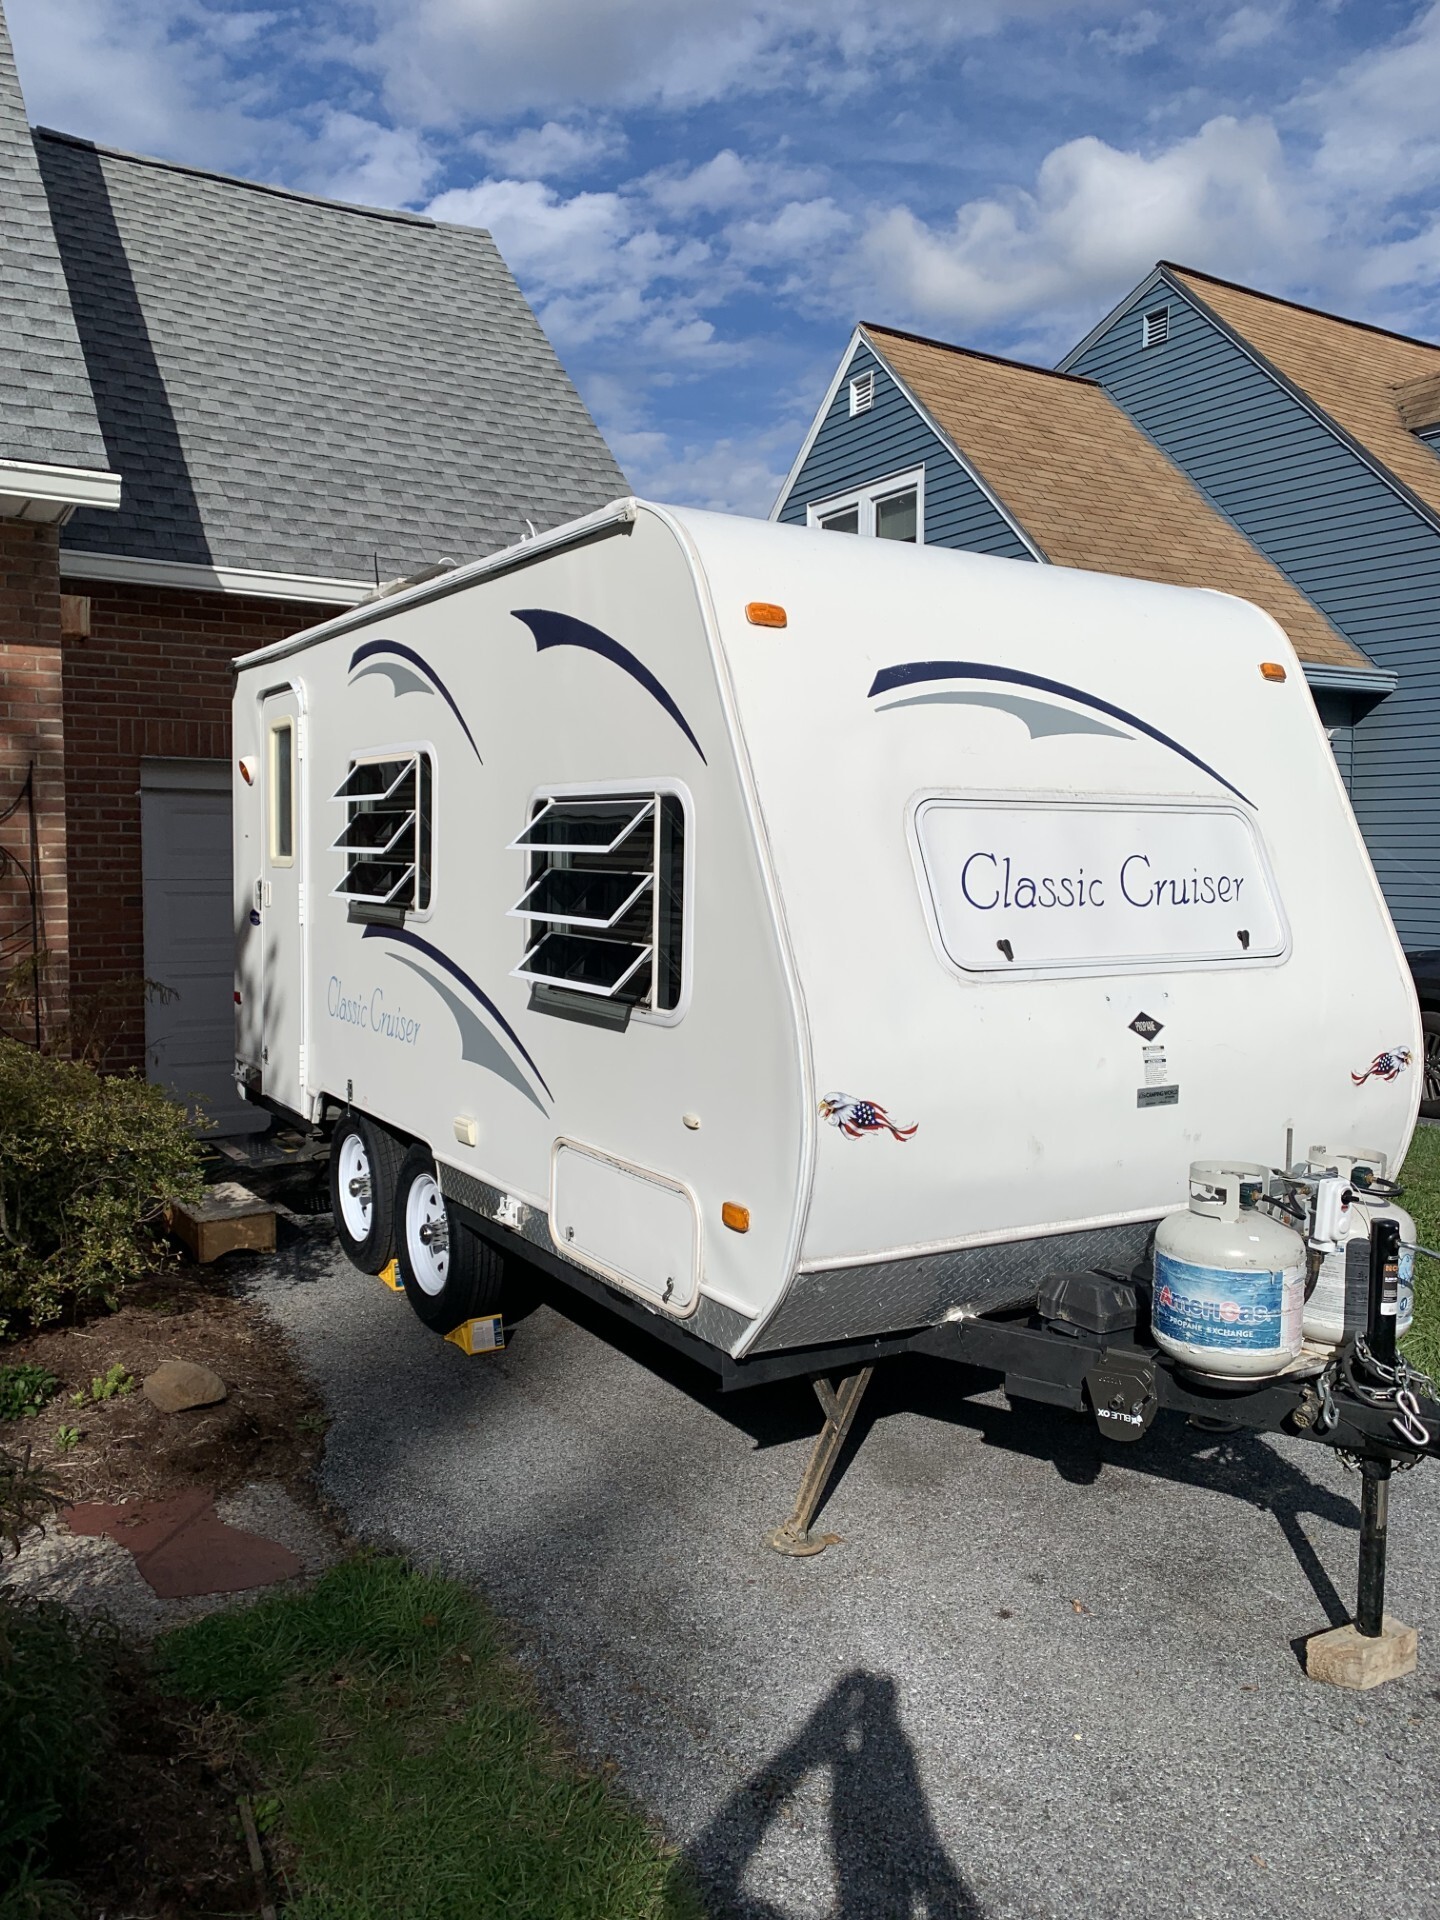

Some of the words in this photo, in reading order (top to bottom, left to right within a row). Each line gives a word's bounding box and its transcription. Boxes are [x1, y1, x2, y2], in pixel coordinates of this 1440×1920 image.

[961, 852, 1105, 910] Classic
[1120, 854, 1244, 907] Cruiser
[328, 975, 367, 1028] Classic
[370, 987, 421, 1046] Cruiser
[1135, 1021, 1156, 1031] PROPANE
[1159, 1284, 1269, 1324] AmeriGas
[1169, 1316, 1203, 1332] PROPANE
[1206, 1327, 1254, 1338] EXCHANGE
[1097, 1408, 1110, 1417] OX
[1111, 1411, 1131, 1422] BLUE
